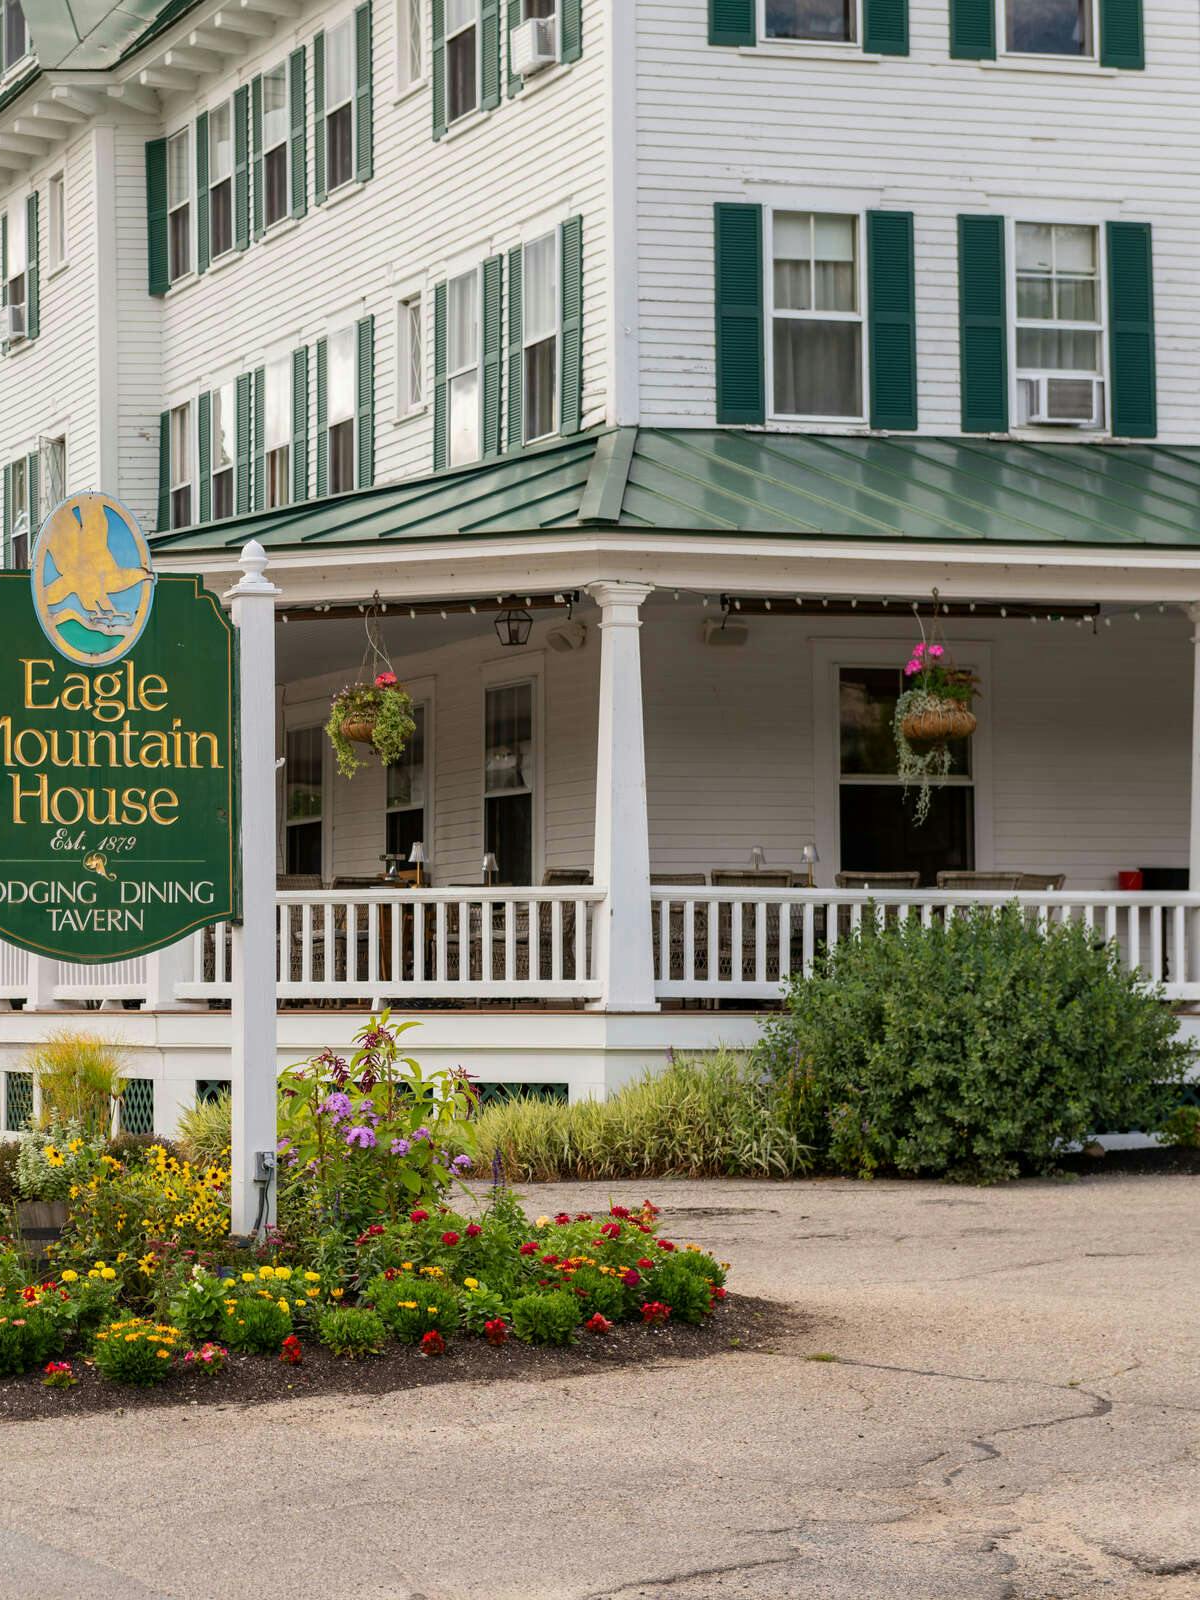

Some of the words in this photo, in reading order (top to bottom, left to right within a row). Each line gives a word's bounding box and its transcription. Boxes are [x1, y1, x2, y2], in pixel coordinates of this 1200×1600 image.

[19, 658, 169, 722] Eagle
[8, 773, 180, 825] House
[50, 829, 86, 851] Est.
[96, 836, 137, 852] 1879
[120, 881, 214, 904] DINING
[46, 909, 144, 932] TAVERN
